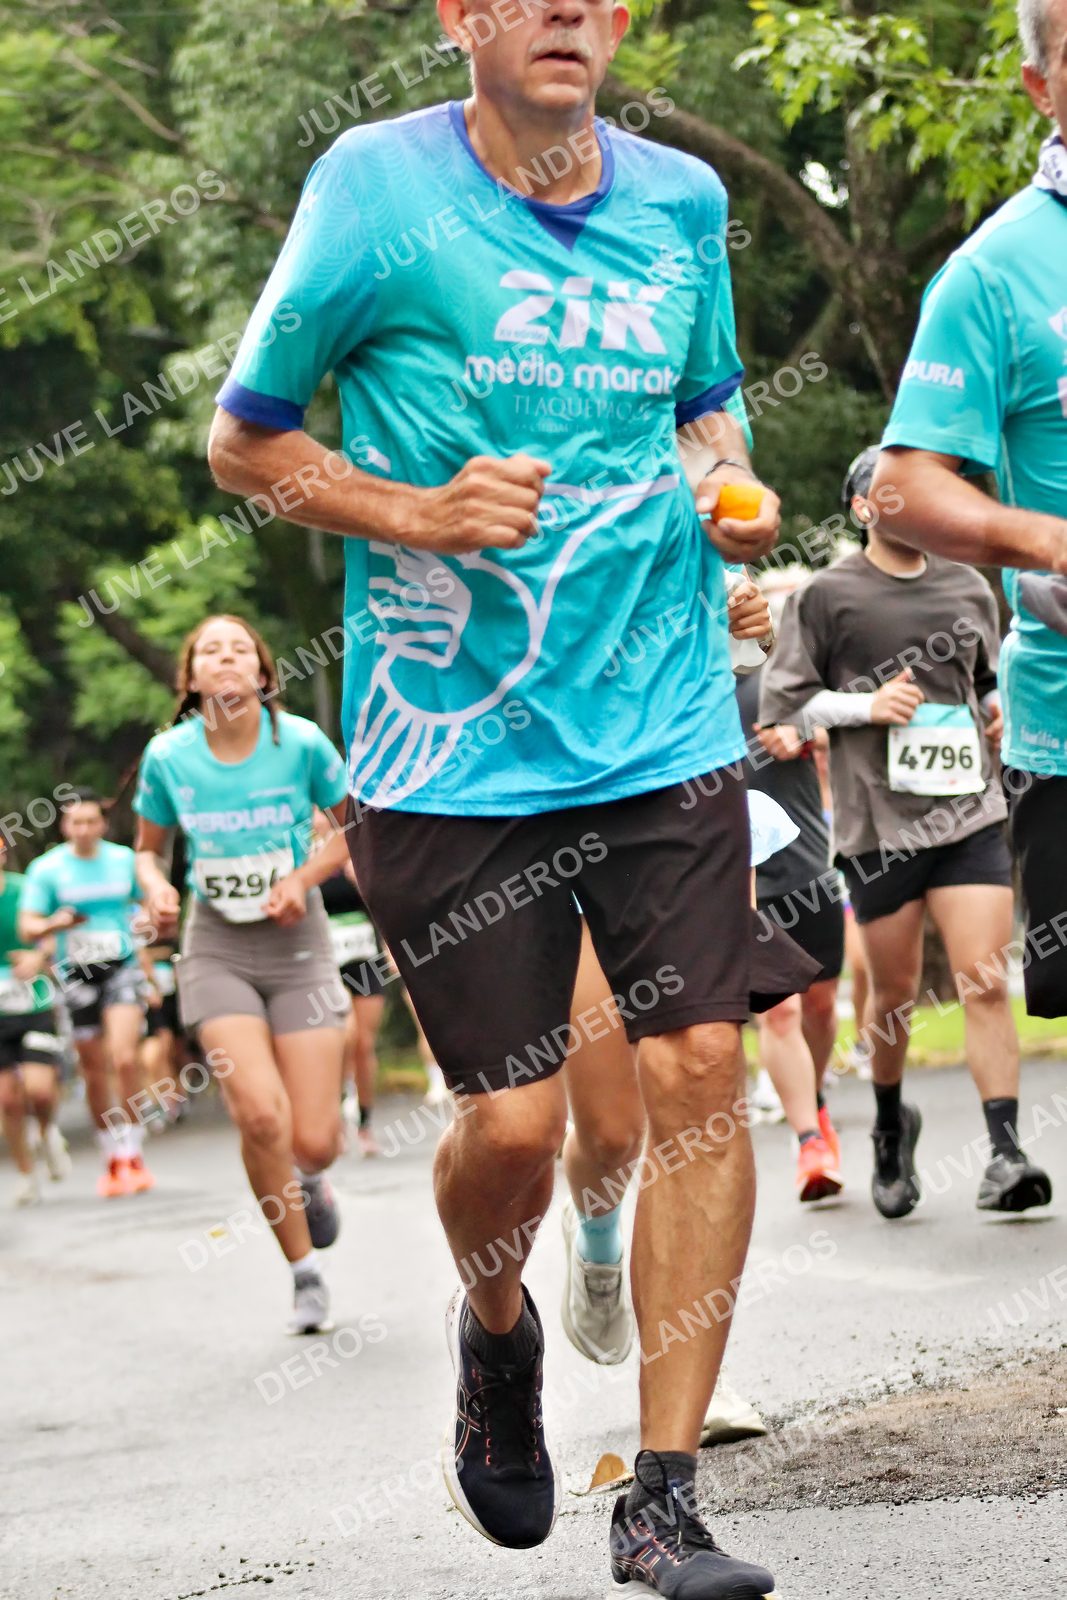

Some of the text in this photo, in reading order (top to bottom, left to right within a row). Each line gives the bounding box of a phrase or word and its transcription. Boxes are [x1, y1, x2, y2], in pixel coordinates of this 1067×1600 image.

[465, 353, 682, 395] medio marat
[898, 745, 973, 770] 4796
[179, 803, 295, 834] PERDURA
